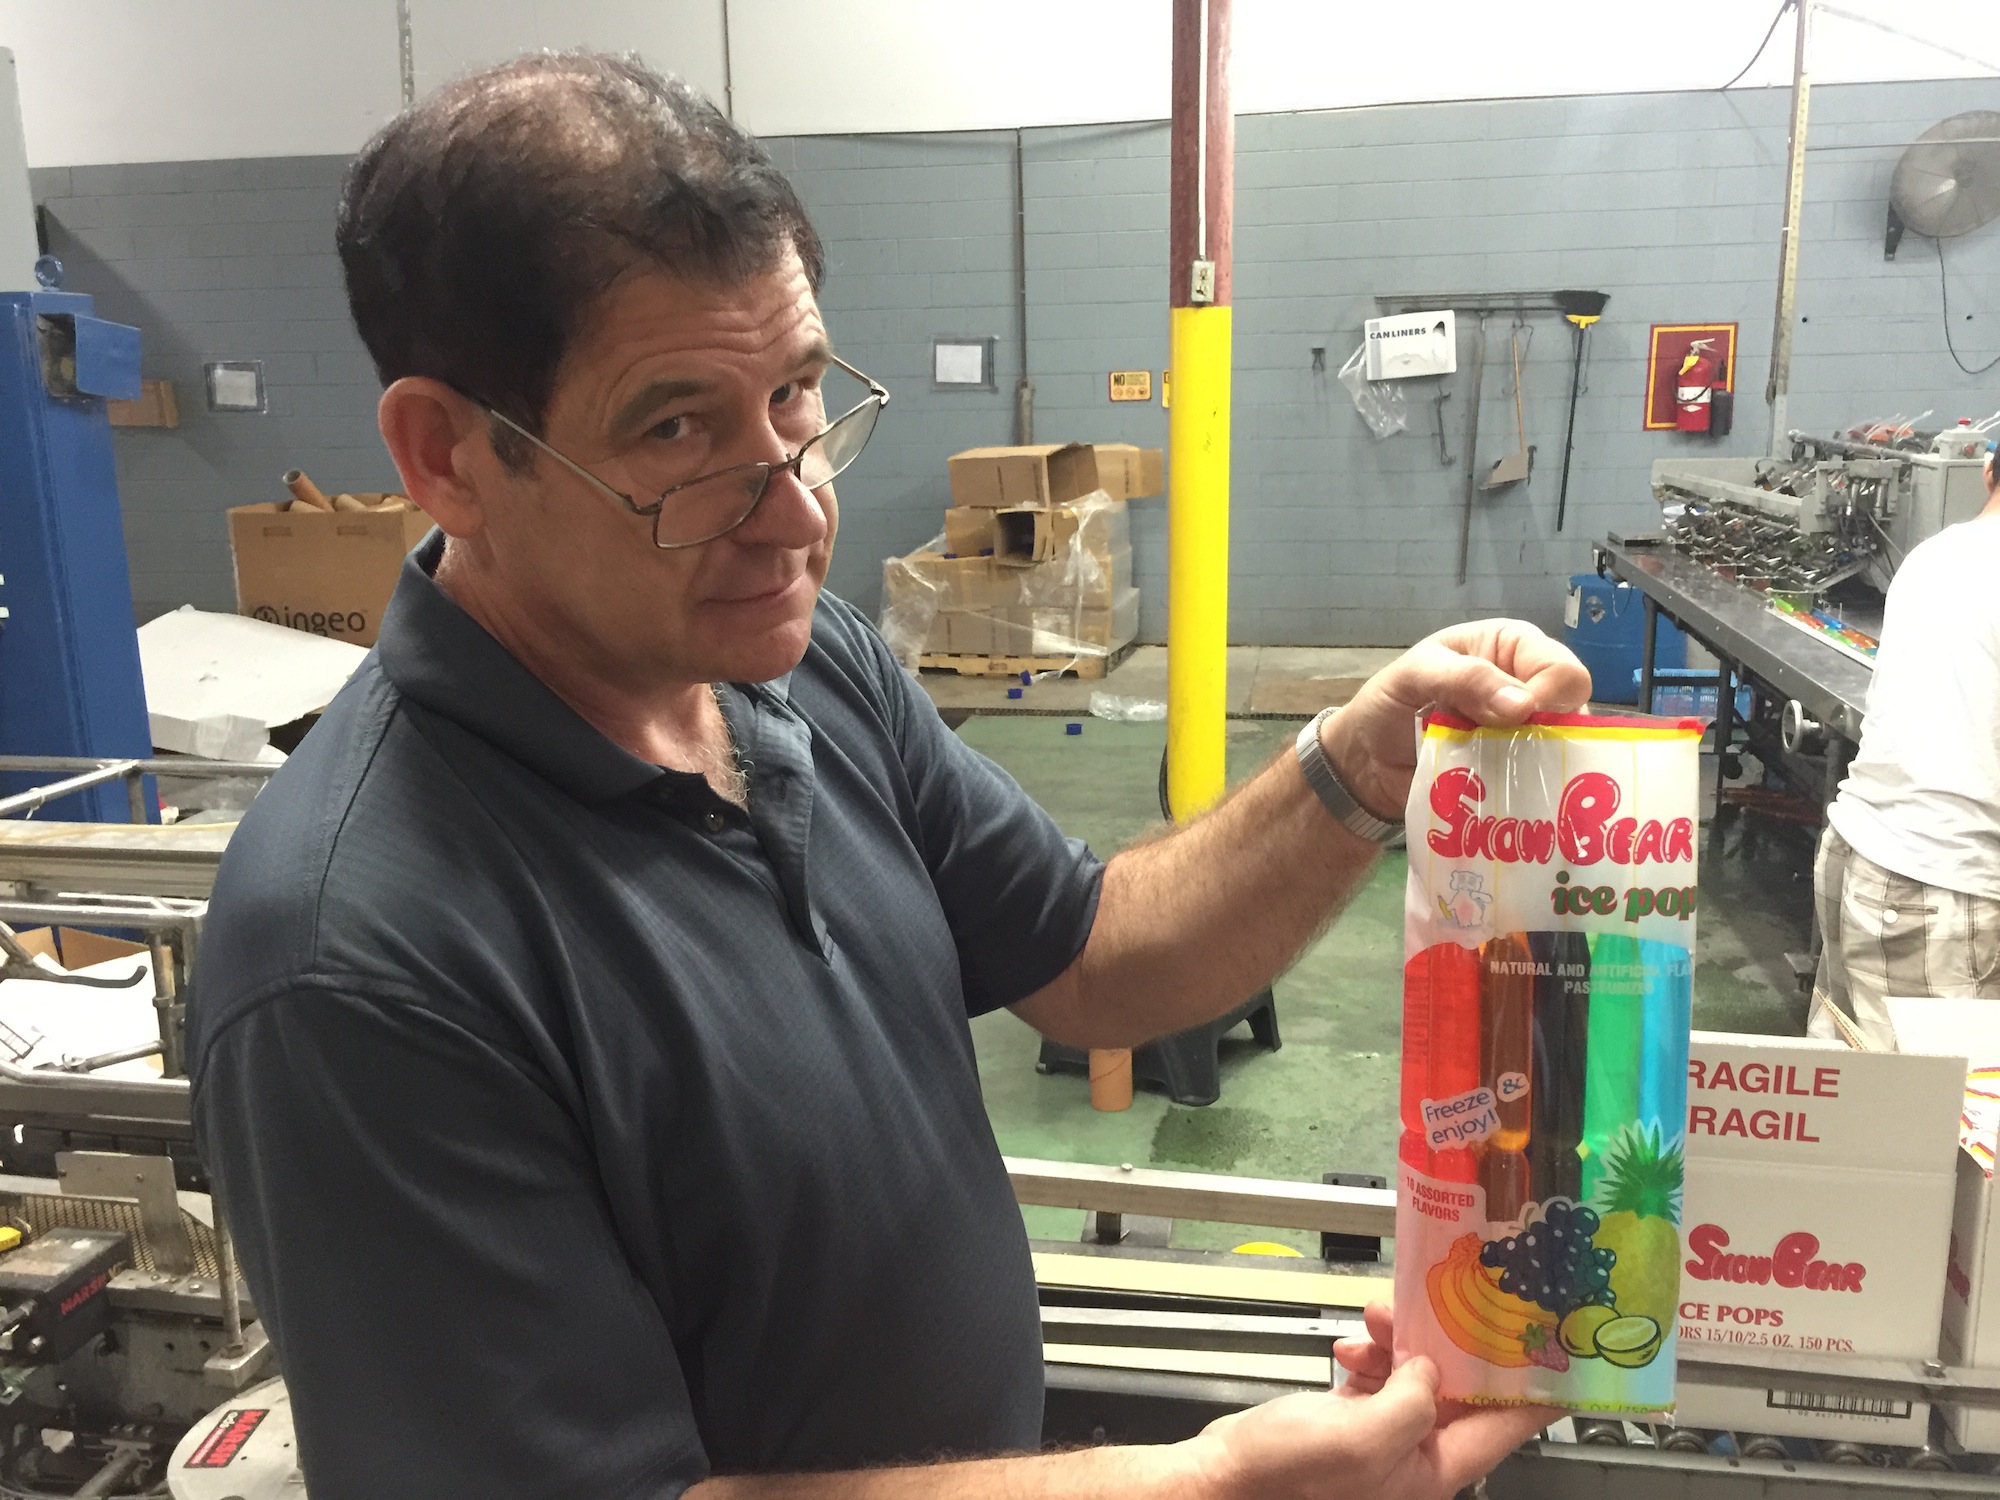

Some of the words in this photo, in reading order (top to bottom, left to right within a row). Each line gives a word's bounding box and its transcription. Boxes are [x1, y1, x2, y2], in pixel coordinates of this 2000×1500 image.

[1370, 331, 1390, 340] CAN
[1392, 327, 1427, 338] LINERS
[1114, 374, 1125, 386] NO
[284, 605, 366, 638] ingeo
[1551, 870, 1618, 916] ice
[1489, 960, 1553, 976] NATURAL
[1556, 963, 1586, 977] AND
[1589, 964, 1660, 978] ARTIFIC
[1425, 1091, 1490, 1124] Freeze
[1502, 1075, 1527, 1095] &
[1432, 1108, 1497, 1145] enjoy!
[1689, 1105, 1820, 1143] RAGIL
[1416, 1184, 1475, 1208] ASSORTED
[1412, 1196, 1460, 1222] FLAVORS
[1716, 1305, 1784, 1328] POPS
[1706, 1328, 1768, 1346] 15/10/2.5
[1772, 1333, 1794, 1348] OZ.
[1799, 1336, 1823, 1350] 150
[1826, 1338, 1856, 1353] PCS.
